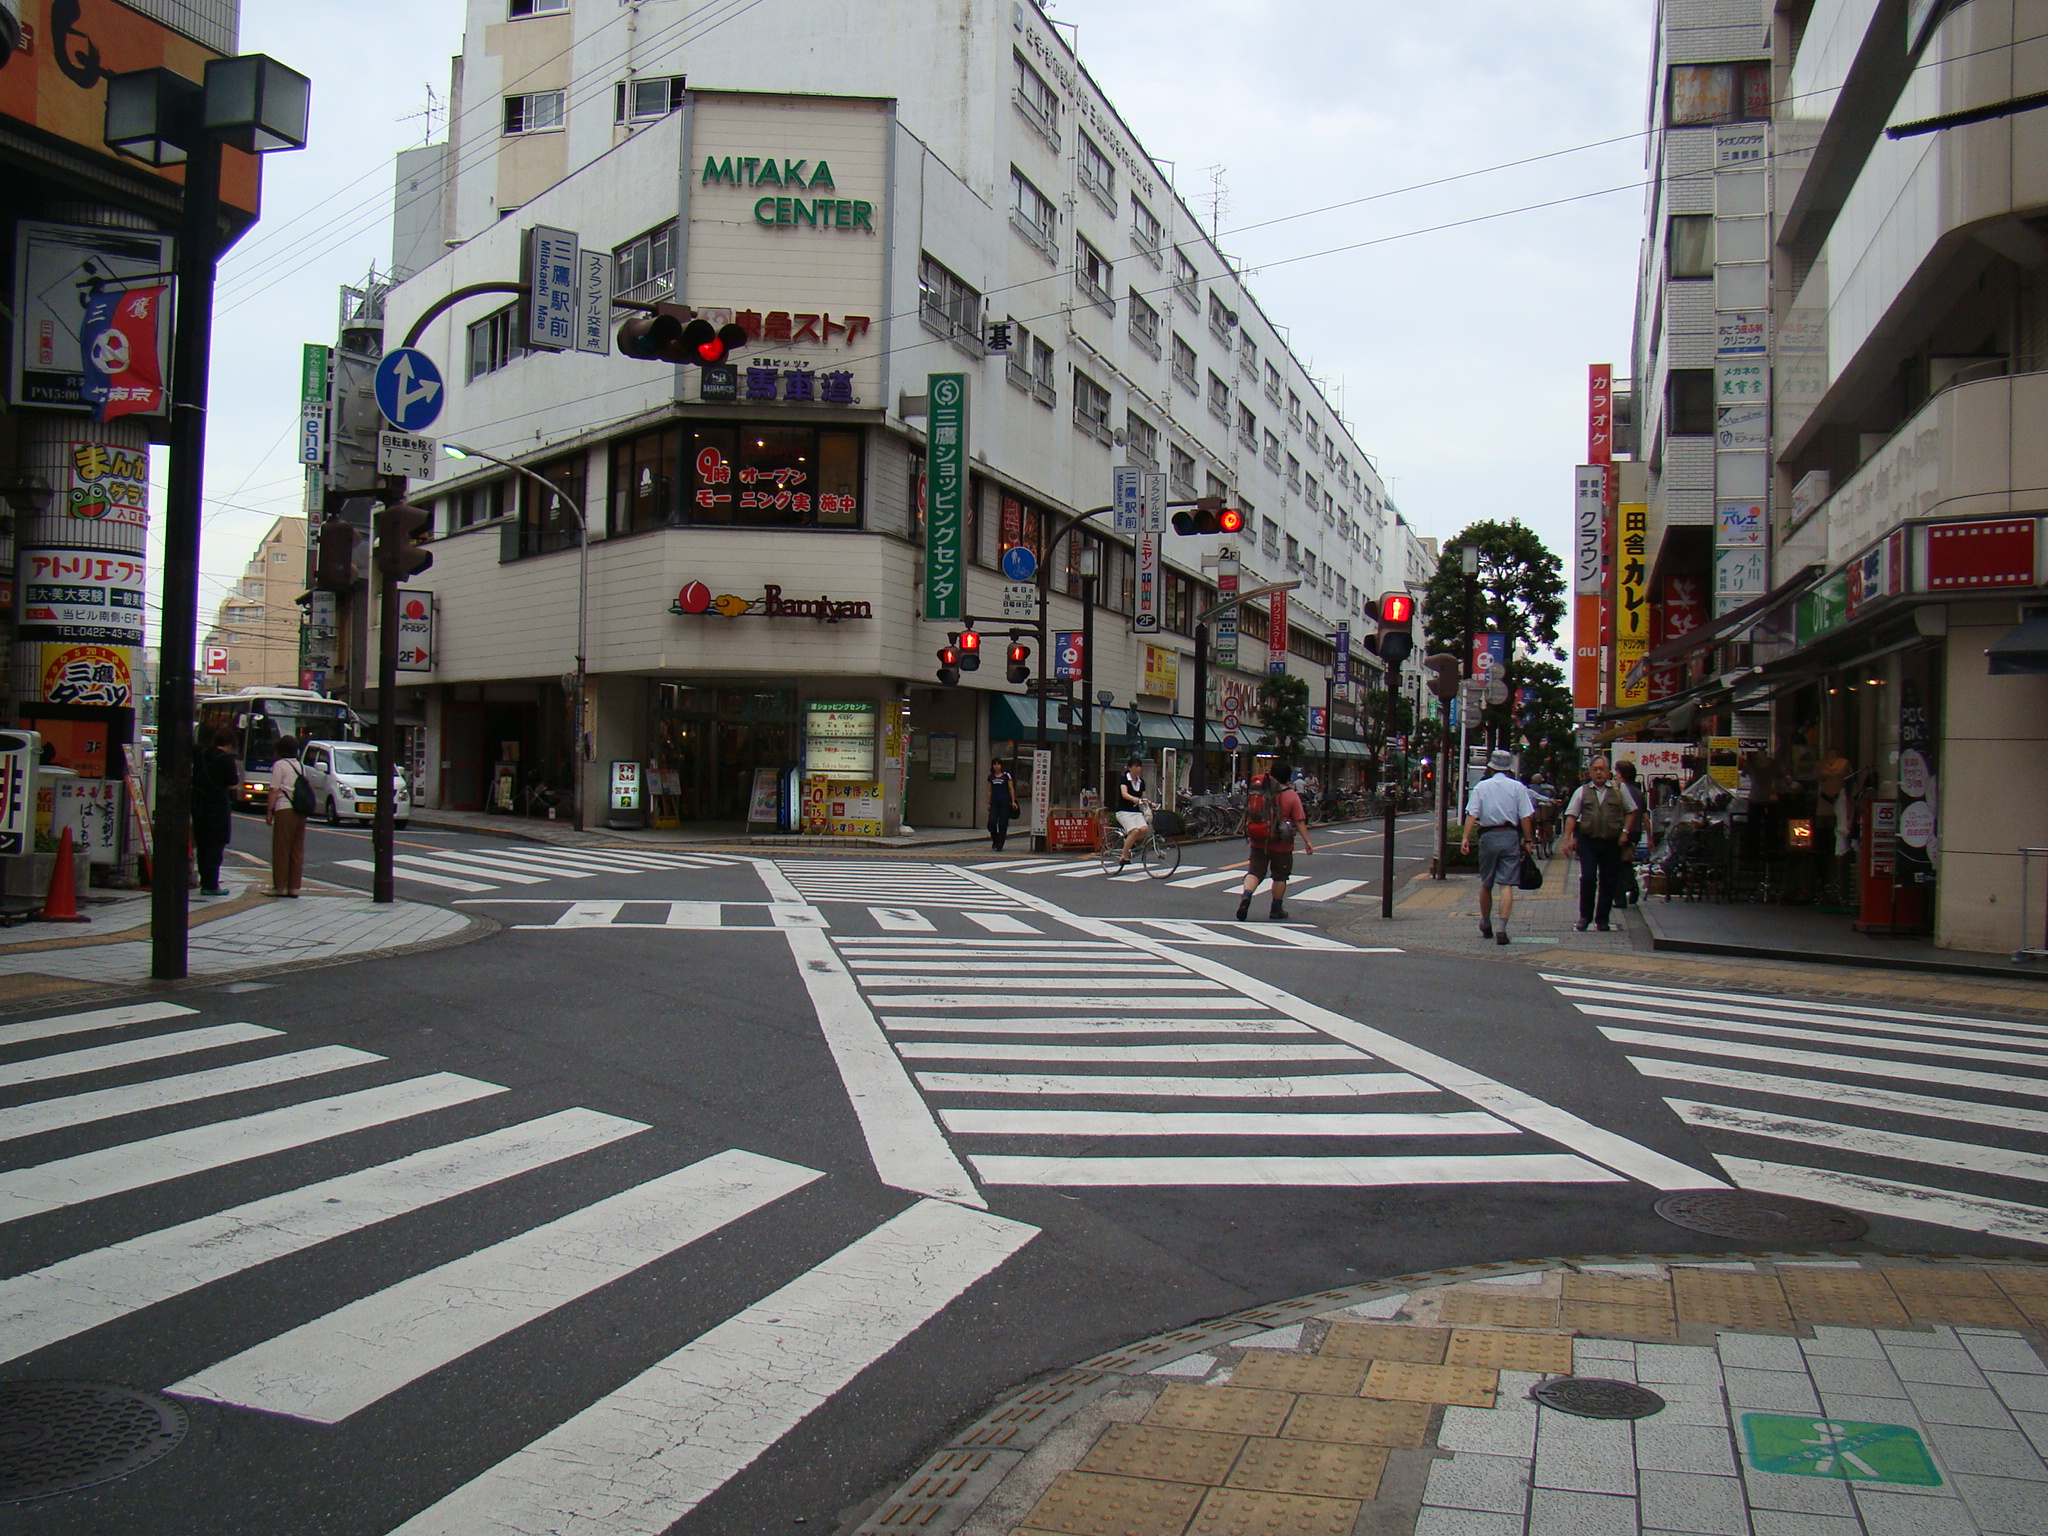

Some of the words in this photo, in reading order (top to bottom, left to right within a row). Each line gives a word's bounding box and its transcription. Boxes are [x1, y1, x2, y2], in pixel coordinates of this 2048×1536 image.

[701, 155, 836, 190] MITAKA
[753, 196, 873, 231] CENTER
[537, 240, 552, 298] Mitakaeki
[550, 239, 572, 339] 三鷹駅前
[537, 304, 549, 330] Mae
[736, 309, 871, 345] 東急ストア
[986, 323, 1013, 351] 碁
[1592, 376, 1608, 446] カラオケ
[304, 420, 319, 461] ena
[382, 435, 433, 451] 自転車を除く
[933, 408, 957, 616] 三鷹ショッピングセンター
[1125, 472, 1137, 529] 三鷹駅前
[1723, 514, 1758, 525] バレエ
[1219, 547, 1237, 560] 2F
[1580, 512, 1598, 581] クラウン
[1621, 512, 1647, 633] 田舎カレー
[1748, 553, 1761, 581] 小川
[764, 584, 873, 624] Bamiyan
[1140, 616, 1152, 625] 2F
[209, 649, 227, 666] P
[399, 650, 415, 662] 2F
[1577, 647, 1597, 657] au
[1227, 700, 1237, 708] 30
[1625, 690, 1641, 698] 2F
[85, 741, 102, 754] 3F
